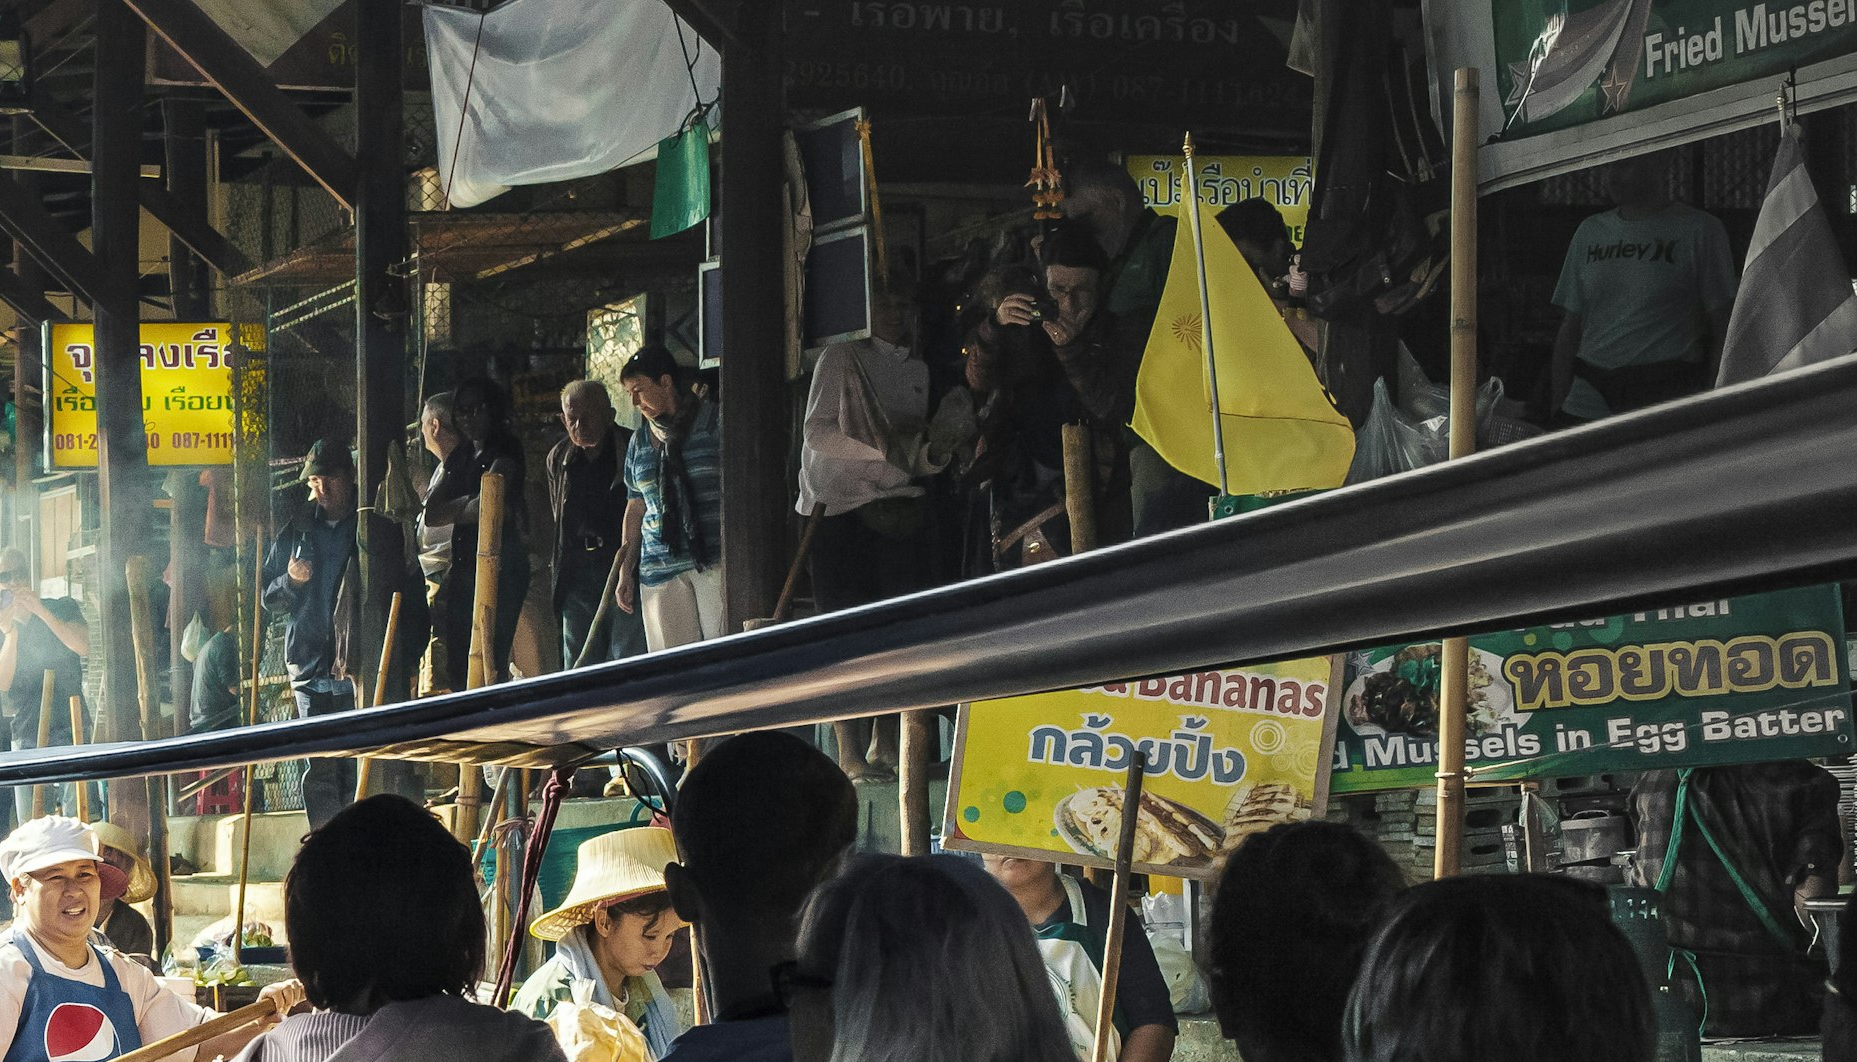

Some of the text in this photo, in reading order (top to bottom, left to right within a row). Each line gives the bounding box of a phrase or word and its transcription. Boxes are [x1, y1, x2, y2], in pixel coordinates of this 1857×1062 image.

[1645, 16, 1723, 79] Fried
[1586, 239, 1651, 265] Hurley
[1508, 634, 1834, 706] หอยทอด
[1030, 714, 1246, 785] กล้วยปิ้ง
[1555, 723, 1592, 753] in
[1607, 716, 1686, 754] Egg
[1701, 707, 1846, 742] Batter
